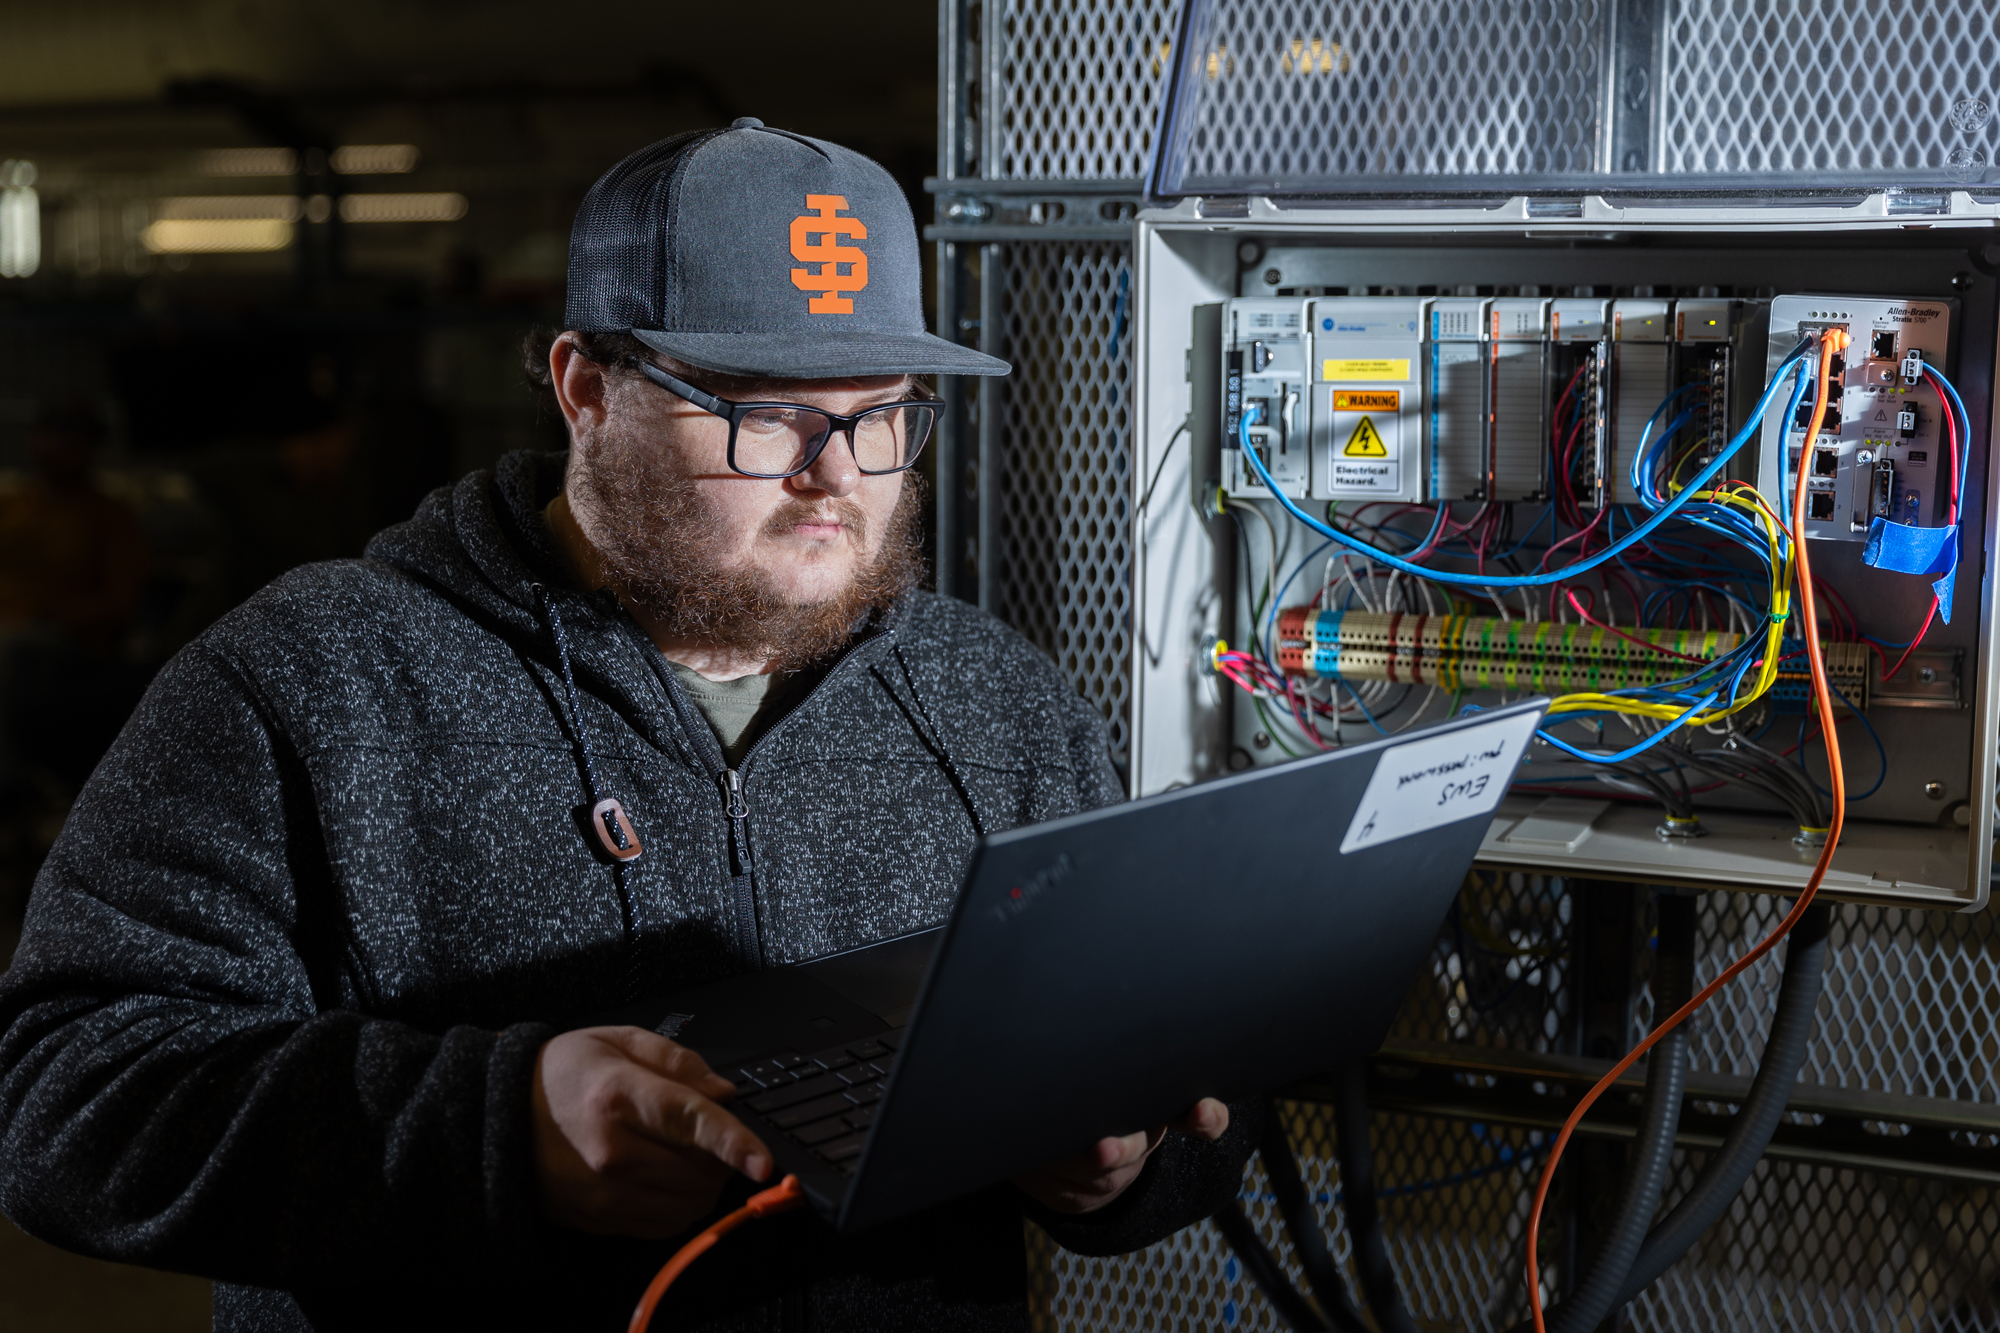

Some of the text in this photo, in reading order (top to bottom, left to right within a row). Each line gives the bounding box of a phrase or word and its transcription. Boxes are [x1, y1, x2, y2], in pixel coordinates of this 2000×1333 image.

[1887, 306, 1940, 318] Allen-Bradley
[1349, 395, 1397, 407] WARNING
[1335, 466, 1389, 475] Electrical
[1335, 476, 1378, 486] Hazard.
[1437, 774, 1491, 806] EWS
